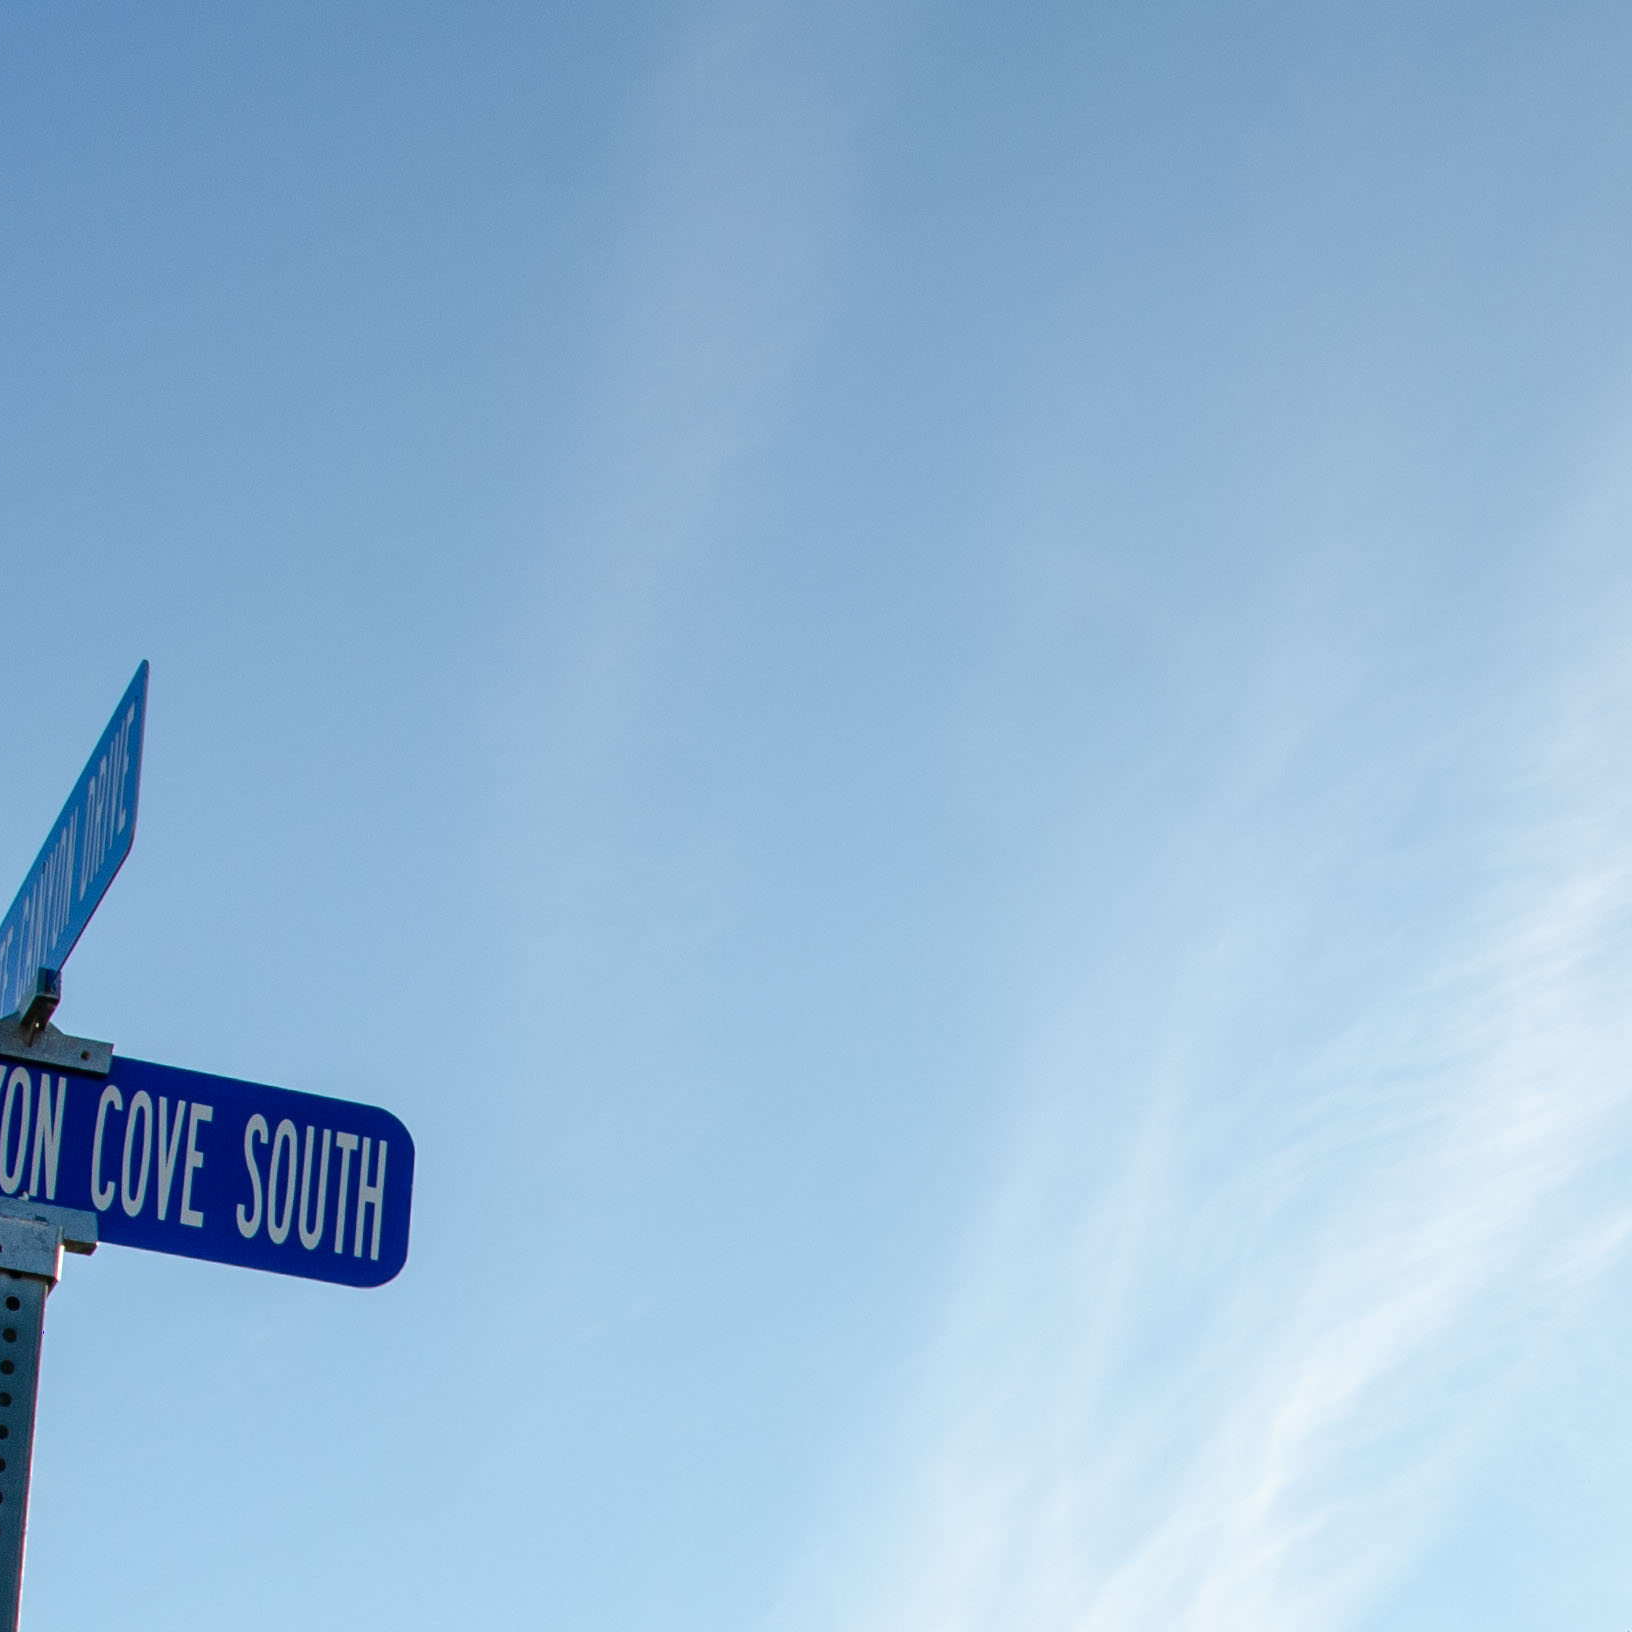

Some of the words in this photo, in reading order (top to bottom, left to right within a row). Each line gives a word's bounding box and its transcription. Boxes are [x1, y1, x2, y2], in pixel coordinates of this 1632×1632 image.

[16, 806, 79, 1009] CANYON
[79, 702, 136, 901] DRIVE
[90, 1084, 213, 1228] COVE
[236, 1113, 388, 1261] SOUTH
